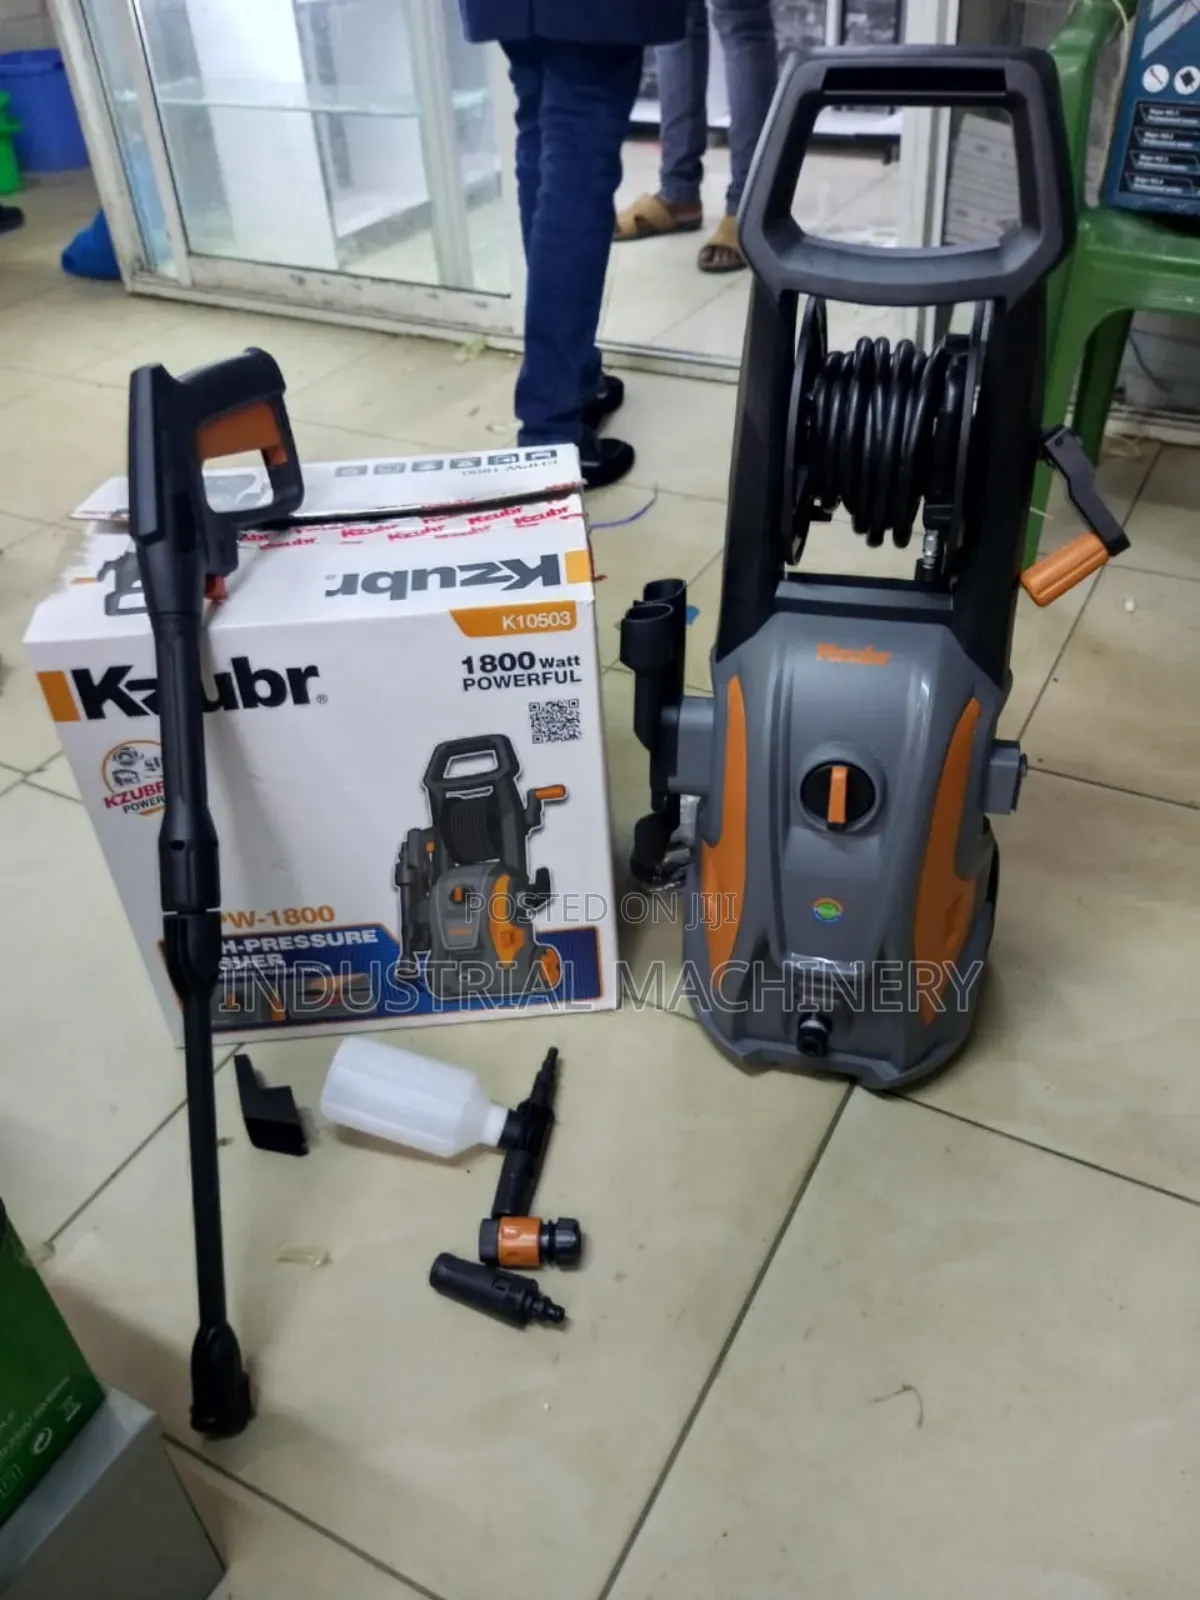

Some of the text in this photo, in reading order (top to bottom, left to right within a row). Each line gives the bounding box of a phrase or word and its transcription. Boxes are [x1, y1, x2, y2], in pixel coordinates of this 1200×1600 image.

[326, 553, 559, 601] Kzubr
[502, 611, 571, 630] K10503
[462, 651, 536, 675] 1800
[463, 670, 582, 691] POWERFUL
[221, 905, 336, 929] W-1800
[221, 929, 379, 955] H-PRESSURE
[219, 953, 285, 971] SHER
